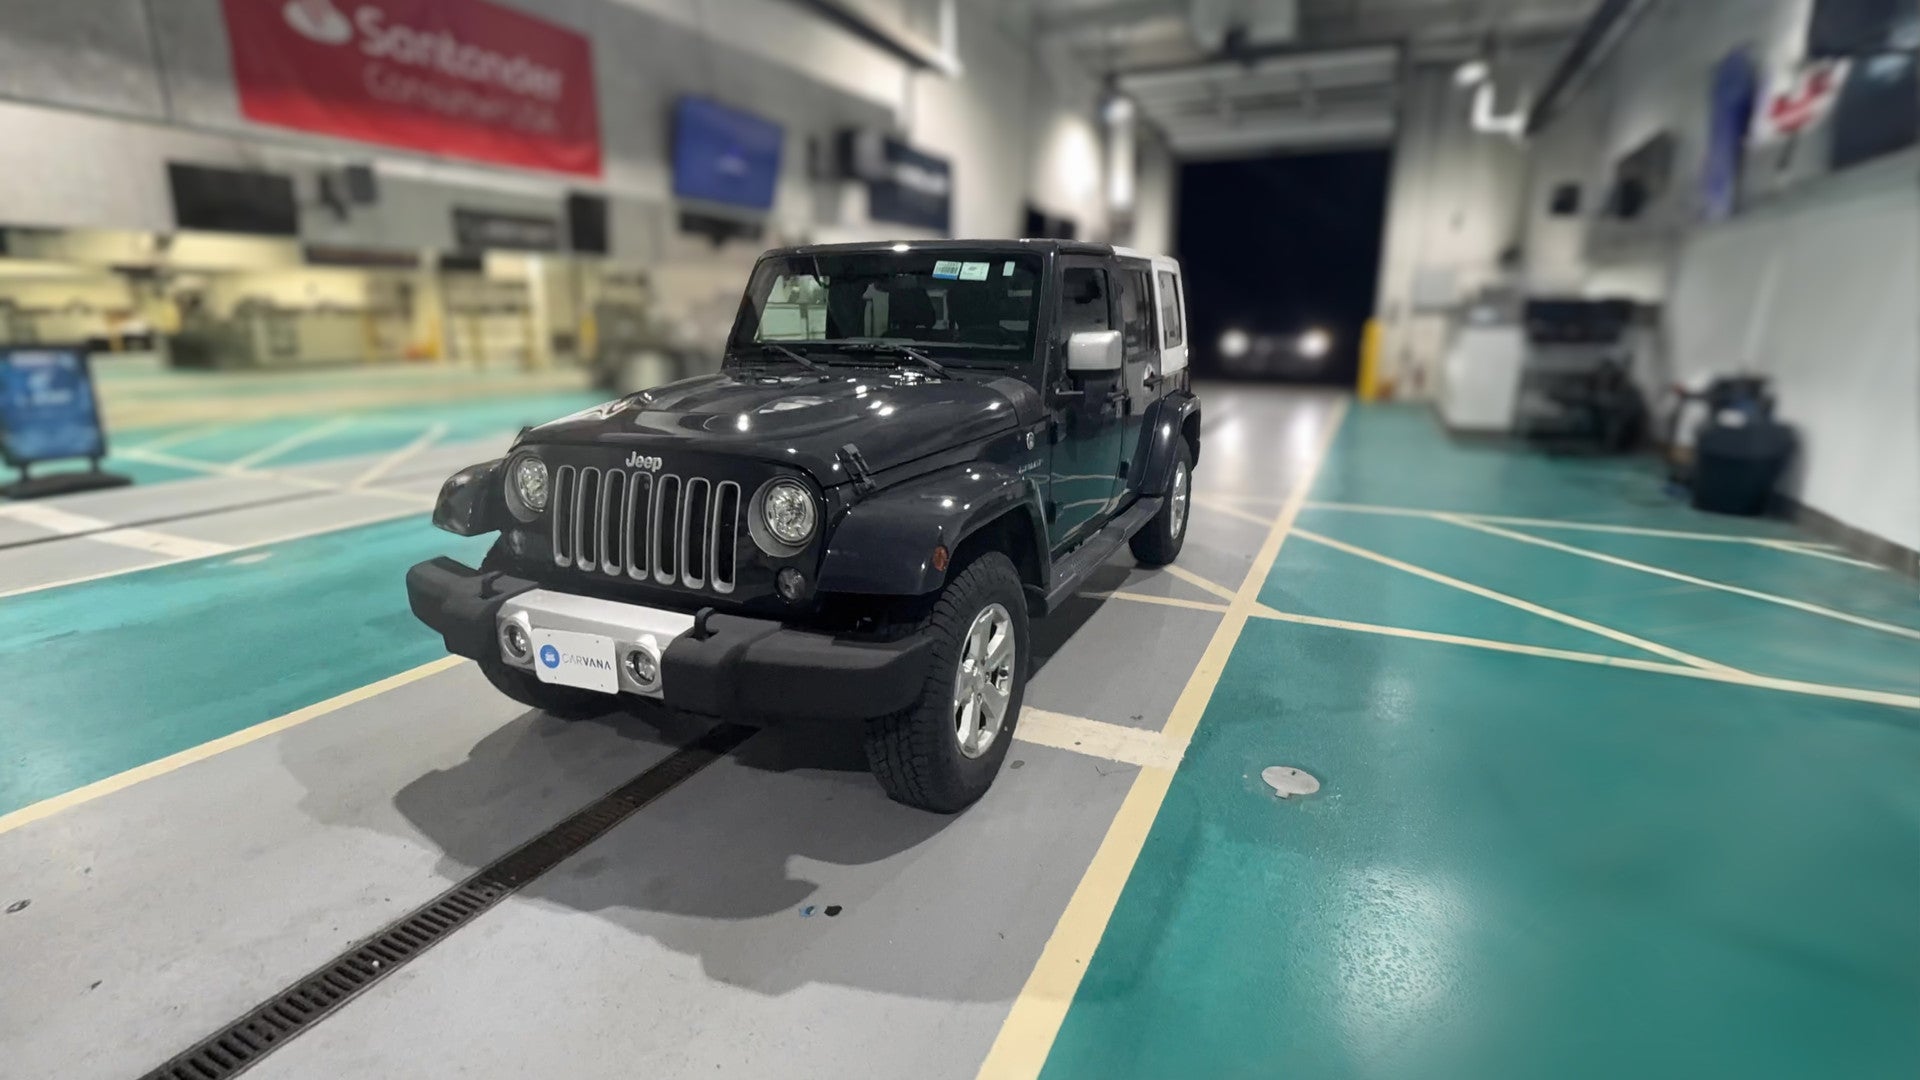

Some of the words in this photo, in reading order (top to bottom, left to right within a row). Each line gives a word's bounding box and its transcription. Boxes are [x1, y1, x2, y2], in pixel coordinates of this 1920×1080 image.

[355, 4, 564, 102] Santander
[625, 451, 663, 472] Jeep
[561, 653, 612, 670] CARVANA
